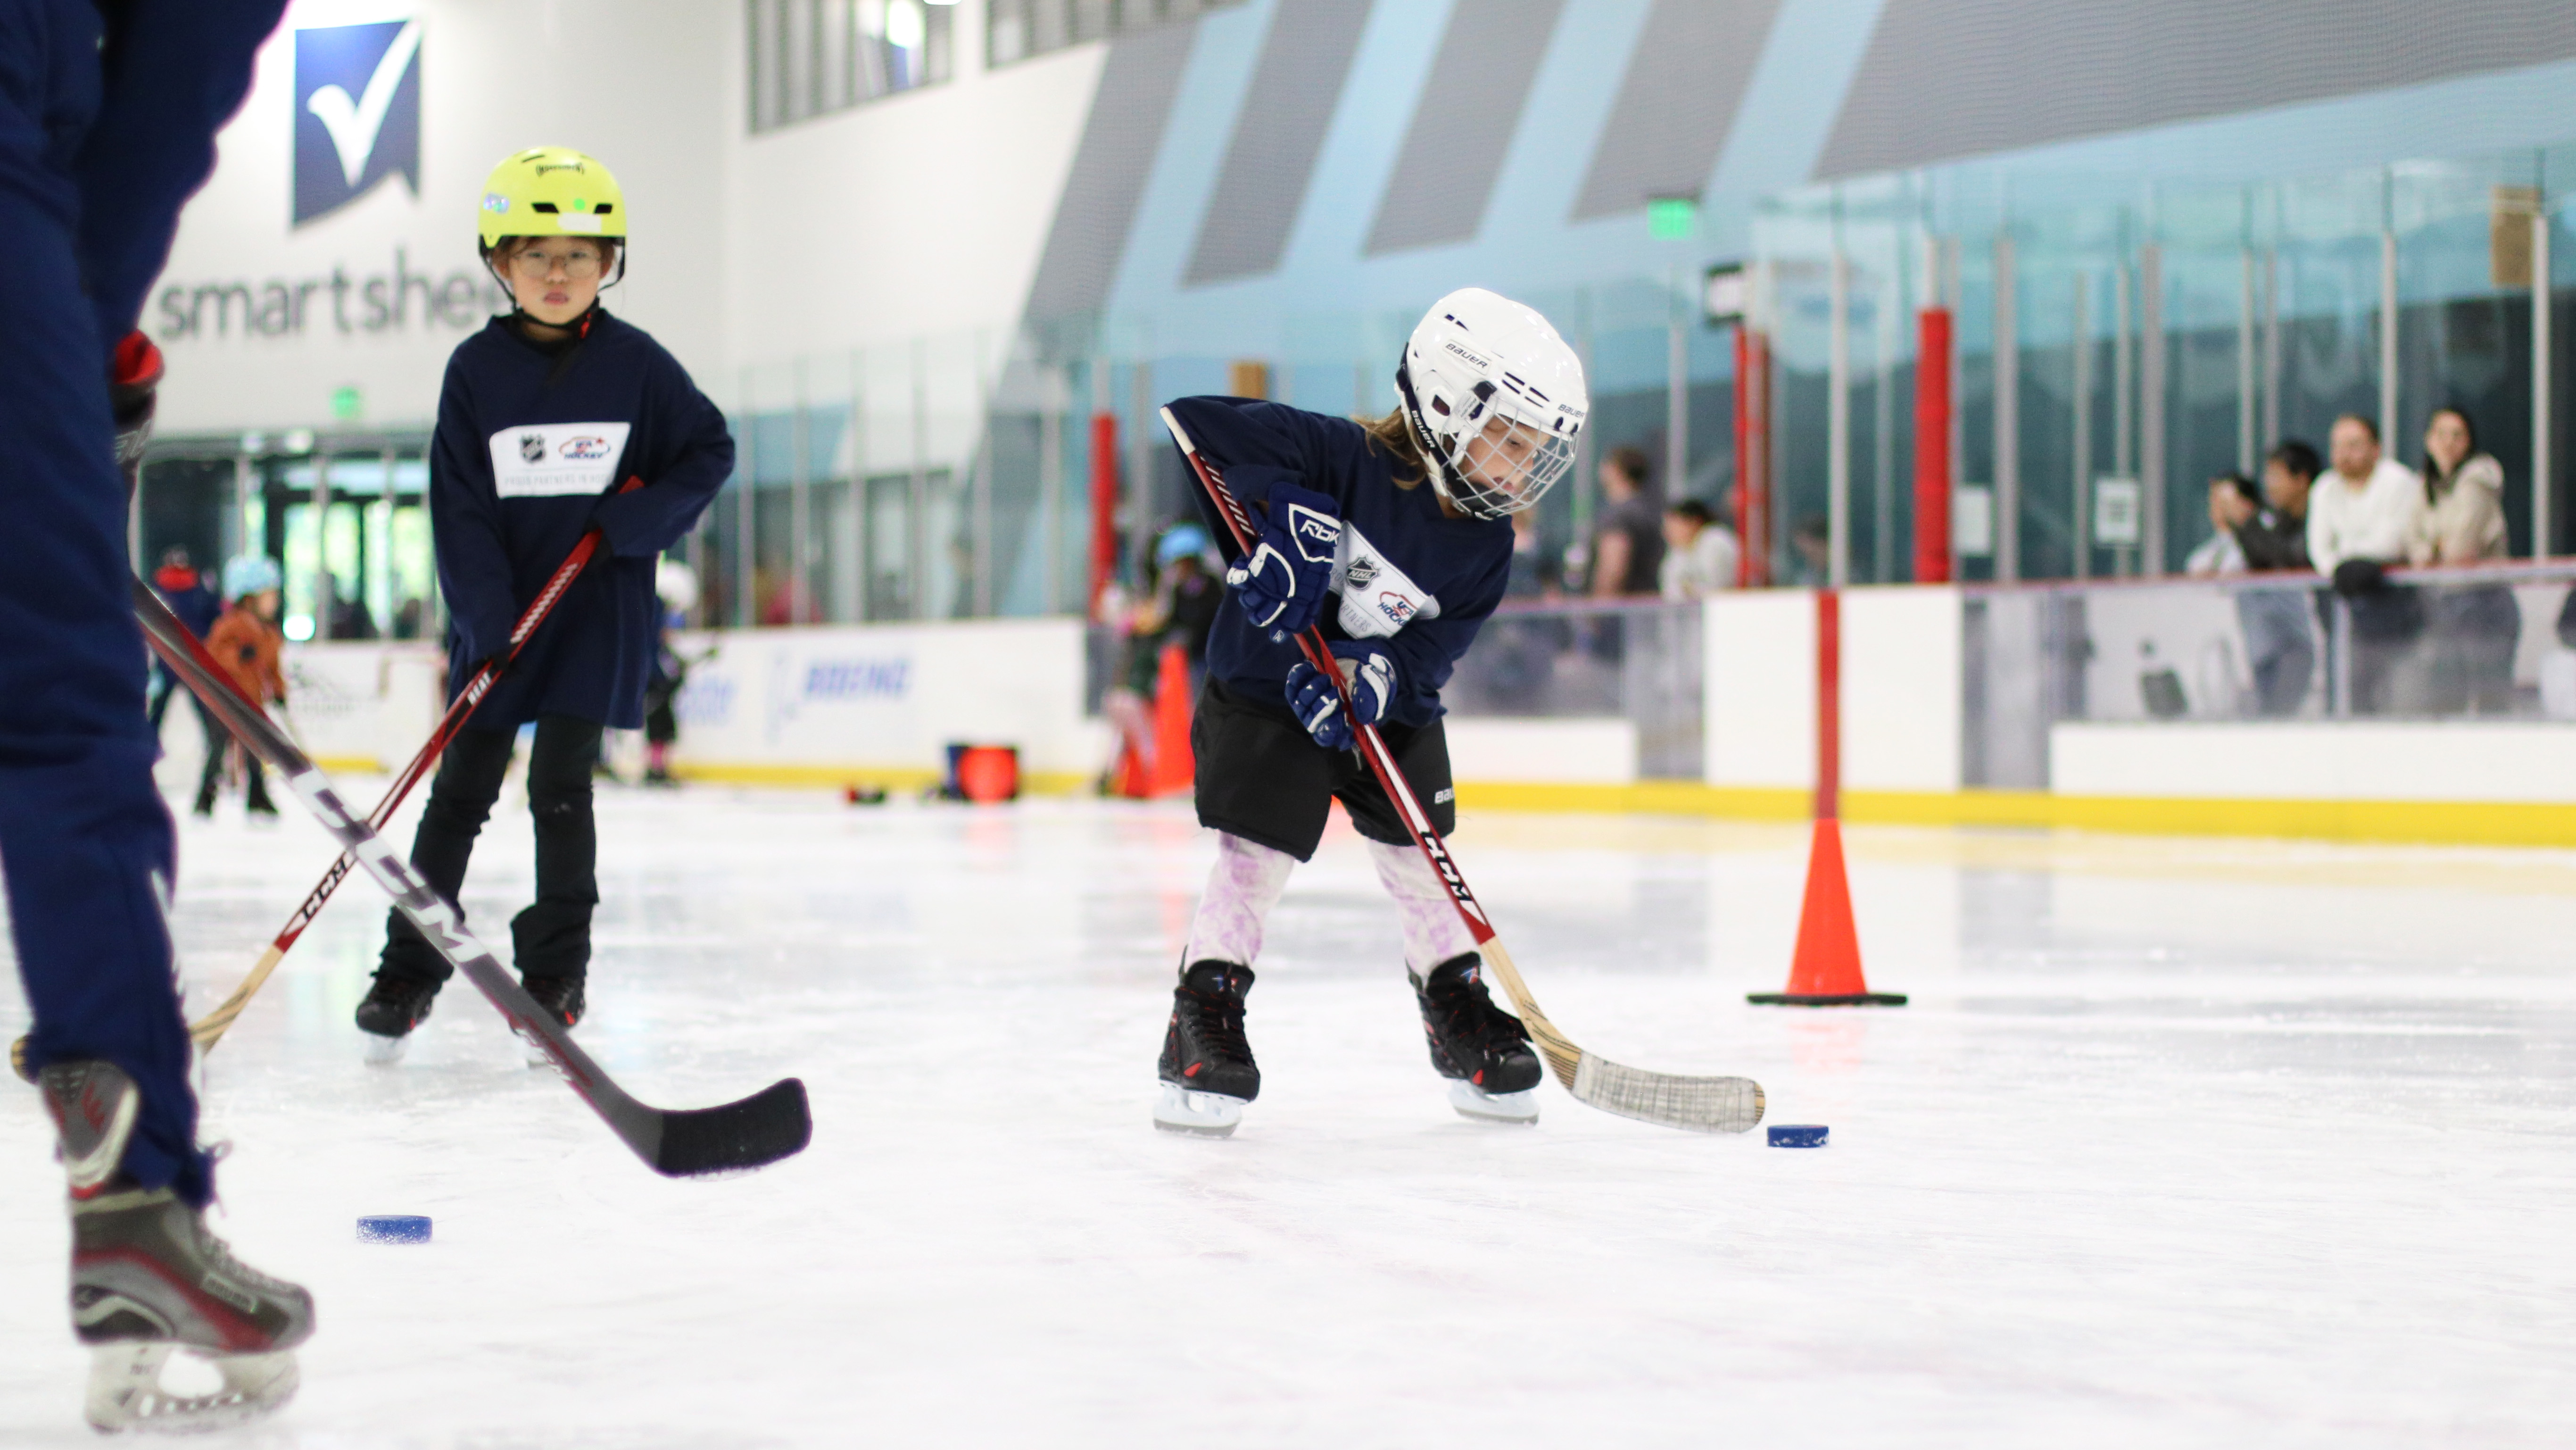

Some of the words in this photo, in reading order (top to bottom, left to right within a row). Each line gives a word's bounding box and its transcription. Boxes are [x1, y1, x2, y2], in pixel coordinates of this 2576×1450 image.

[158, 247, 505, 338] smartshe
[1445, 343, 1488, 368] BAUER
[1557, 404, 1585, 418] BAUER
[1412, 410, 1435, 448] BAUER
[1349, 570, 1373, 578] NHL
[1377, 601, 1408, 626] HOCK
[1434, 787, 1455, 804] BAU
[292, 769, 489, 963] CCM
